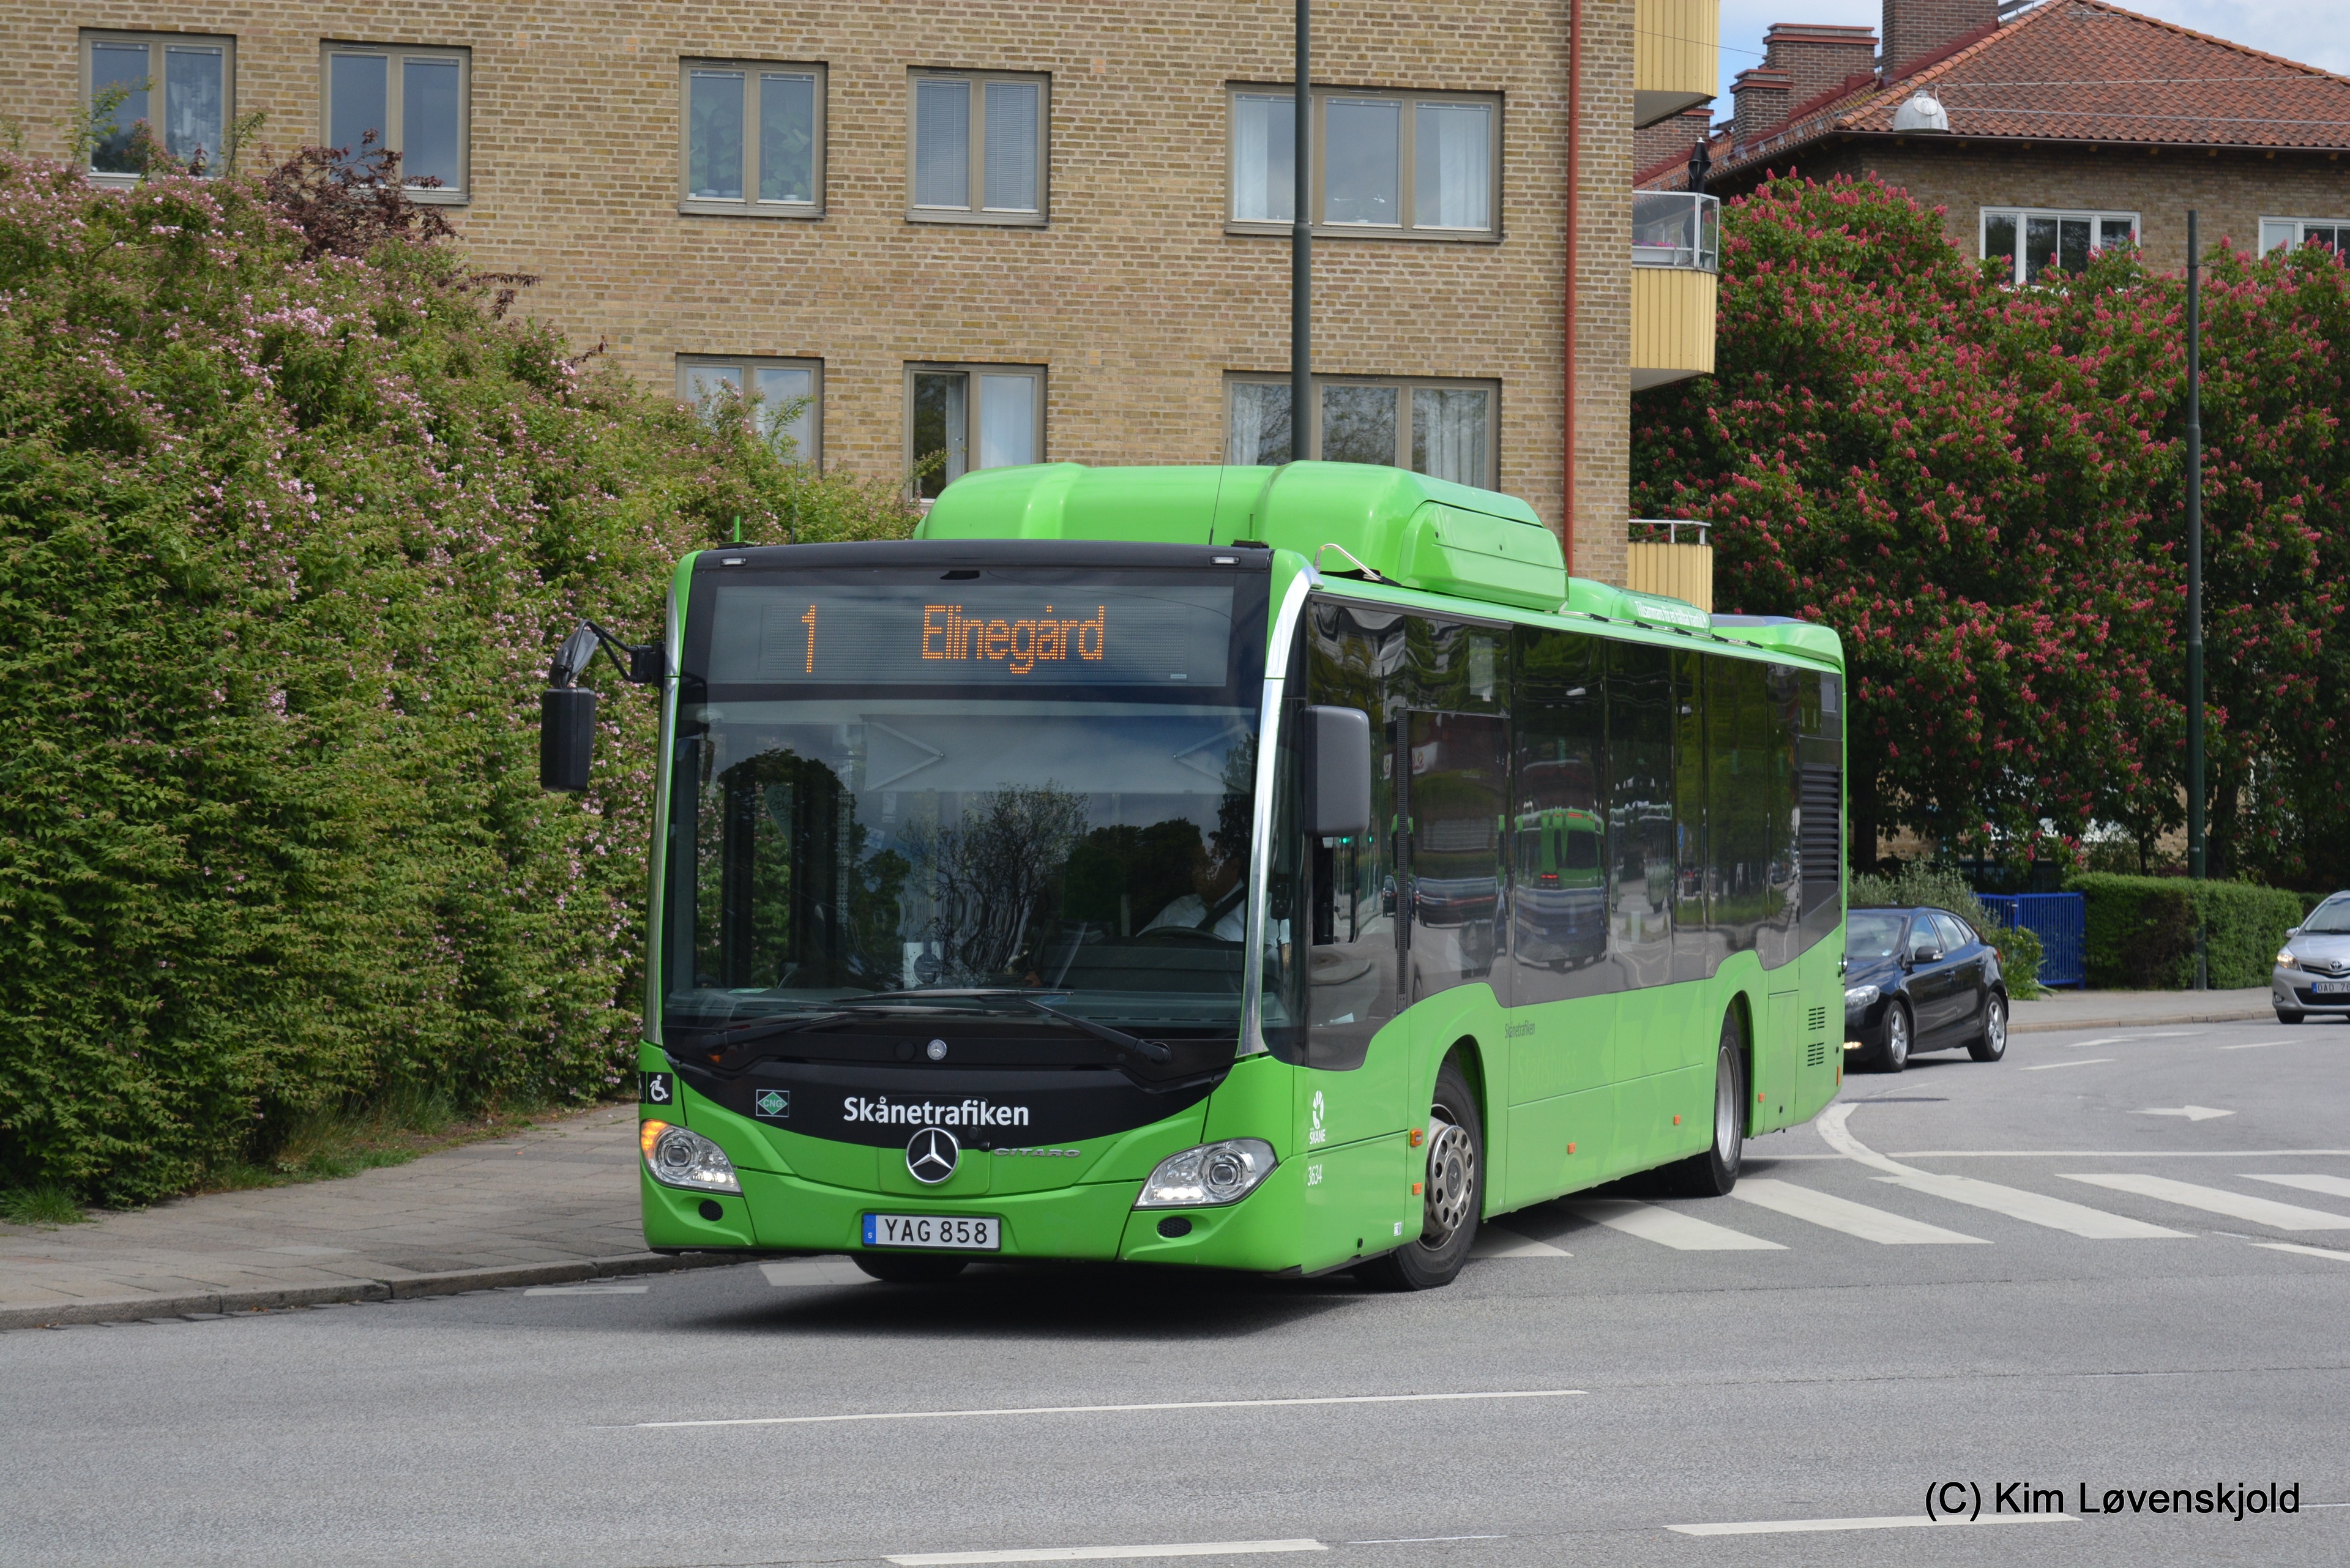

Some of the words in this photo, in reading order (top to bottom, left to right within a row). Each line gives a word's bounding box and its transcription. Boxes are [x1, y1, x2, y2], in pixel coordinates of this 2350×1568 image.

[802, 605, 816, 673] 1
[922, 605, 1105, 674] Elinegård
[1505, 1020, 1535, 1038] Skånetrafiken
[763, 1099, 783, 1108] CNG
[843, 1096, 1029, 1126] Skånetrafiken
[993, 1148, 1080, 1157] CITARO
[1307, 1164, 1322, 1186] 3634
[885, 1219, 930, 1242] YAG
[940, 1220, 987, 1244] 858
